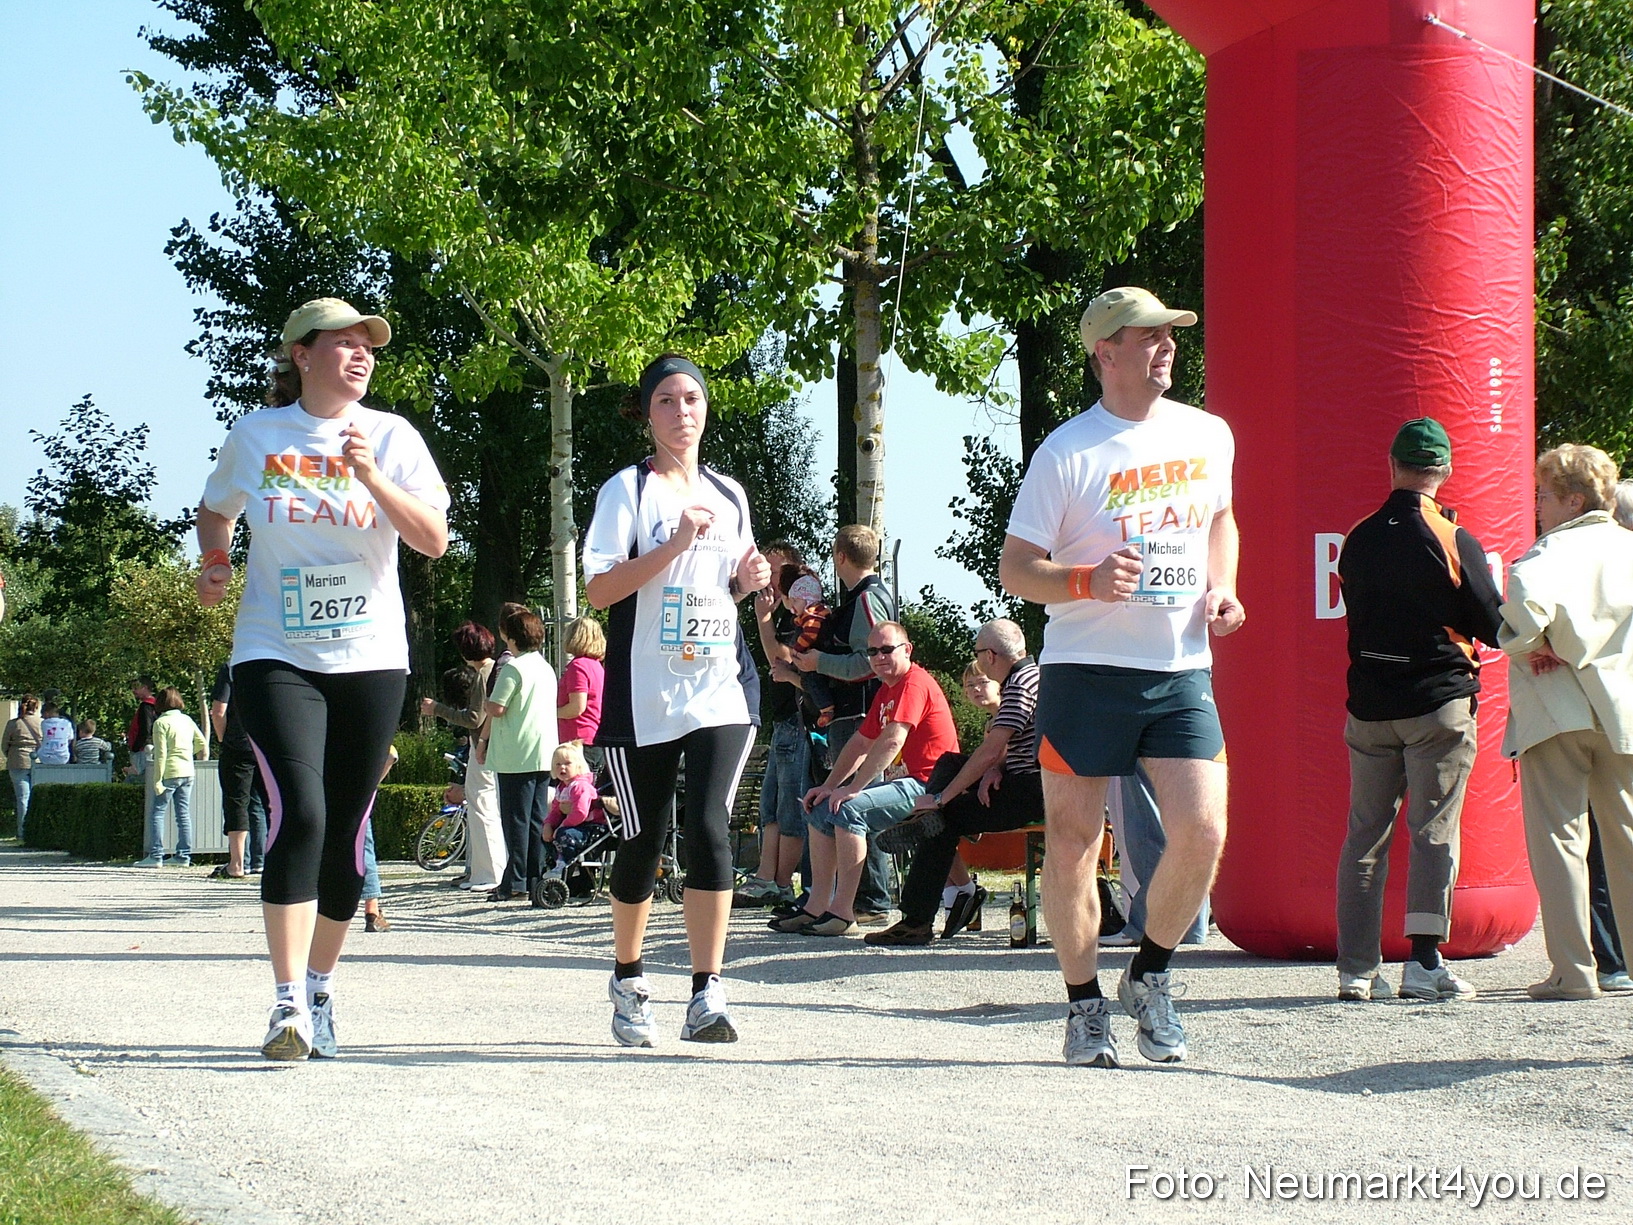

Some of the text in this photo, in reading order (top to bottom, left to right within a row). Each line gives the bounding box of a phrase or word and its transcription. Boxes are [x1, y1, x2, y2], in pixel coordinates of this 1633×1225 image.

[1489, 357, 1503, 395] 1929
[265, 454, 354, 478] MER
[1109, 457, 1207, 494] MERZ
[258, 469, 350, 491] Reisen
[1105, 480, 1188, 510] Reisen
[263, 497, 377, 529] TEAM
[1112, 503, 1209, 542] TEAM
[1148, 541, 1186, 554] Michael
[305, 574, 347, 588] Marion
[1150, 567, 1197, 586] 2686
[309, 595, 367, 620] 2672
[665, 613, 671, 622] C
[686, 618, 730, 637] 2728
